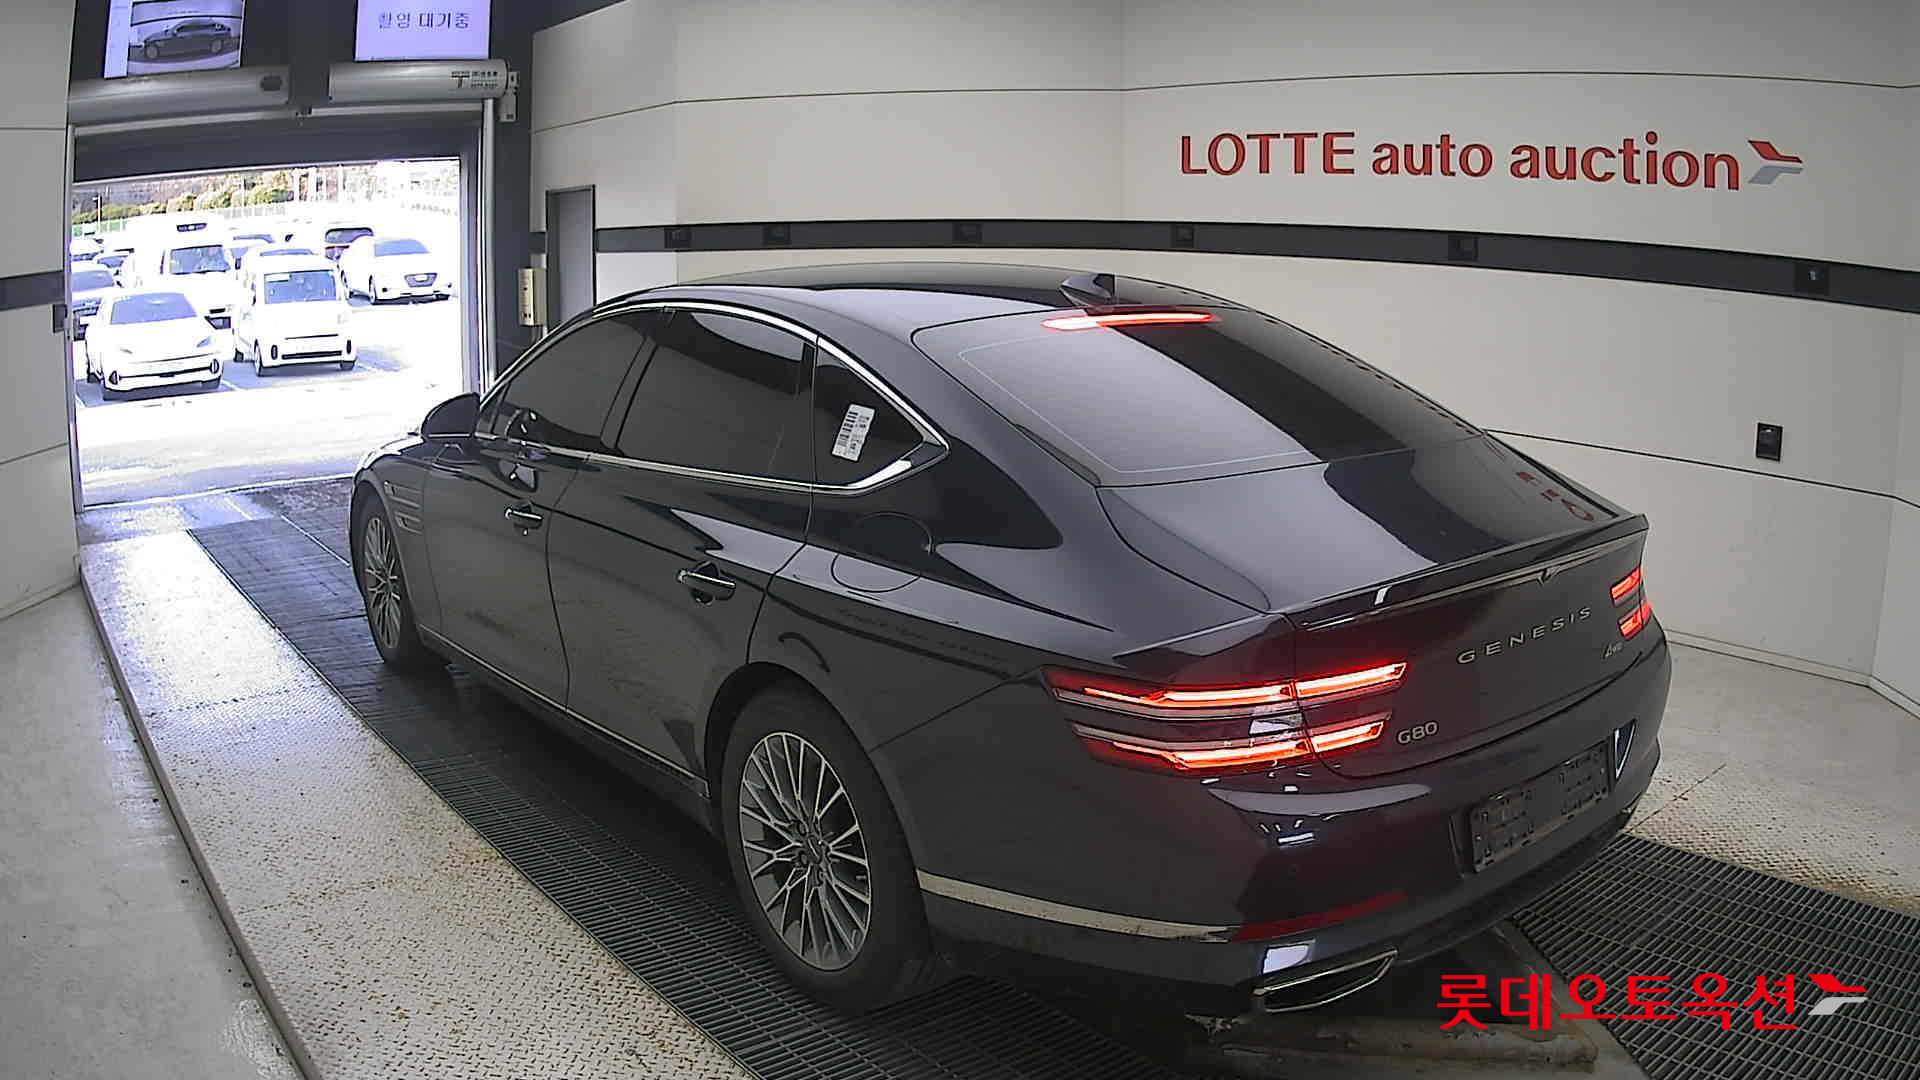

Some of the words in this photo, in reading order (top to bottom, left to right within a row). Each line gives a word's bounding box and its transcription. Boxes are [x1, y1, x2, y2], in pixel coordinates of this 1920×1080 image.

[419, 12, 470, 29] 대기중
[1181, 131, 1355, 176] LOTTE
[1372, 134, 1494, 177] auto
[1511, 131, 1740, 190] auction
[1457, 607, 1591, 663] GENESIS
[1397, 721, 1439, 744] G80
